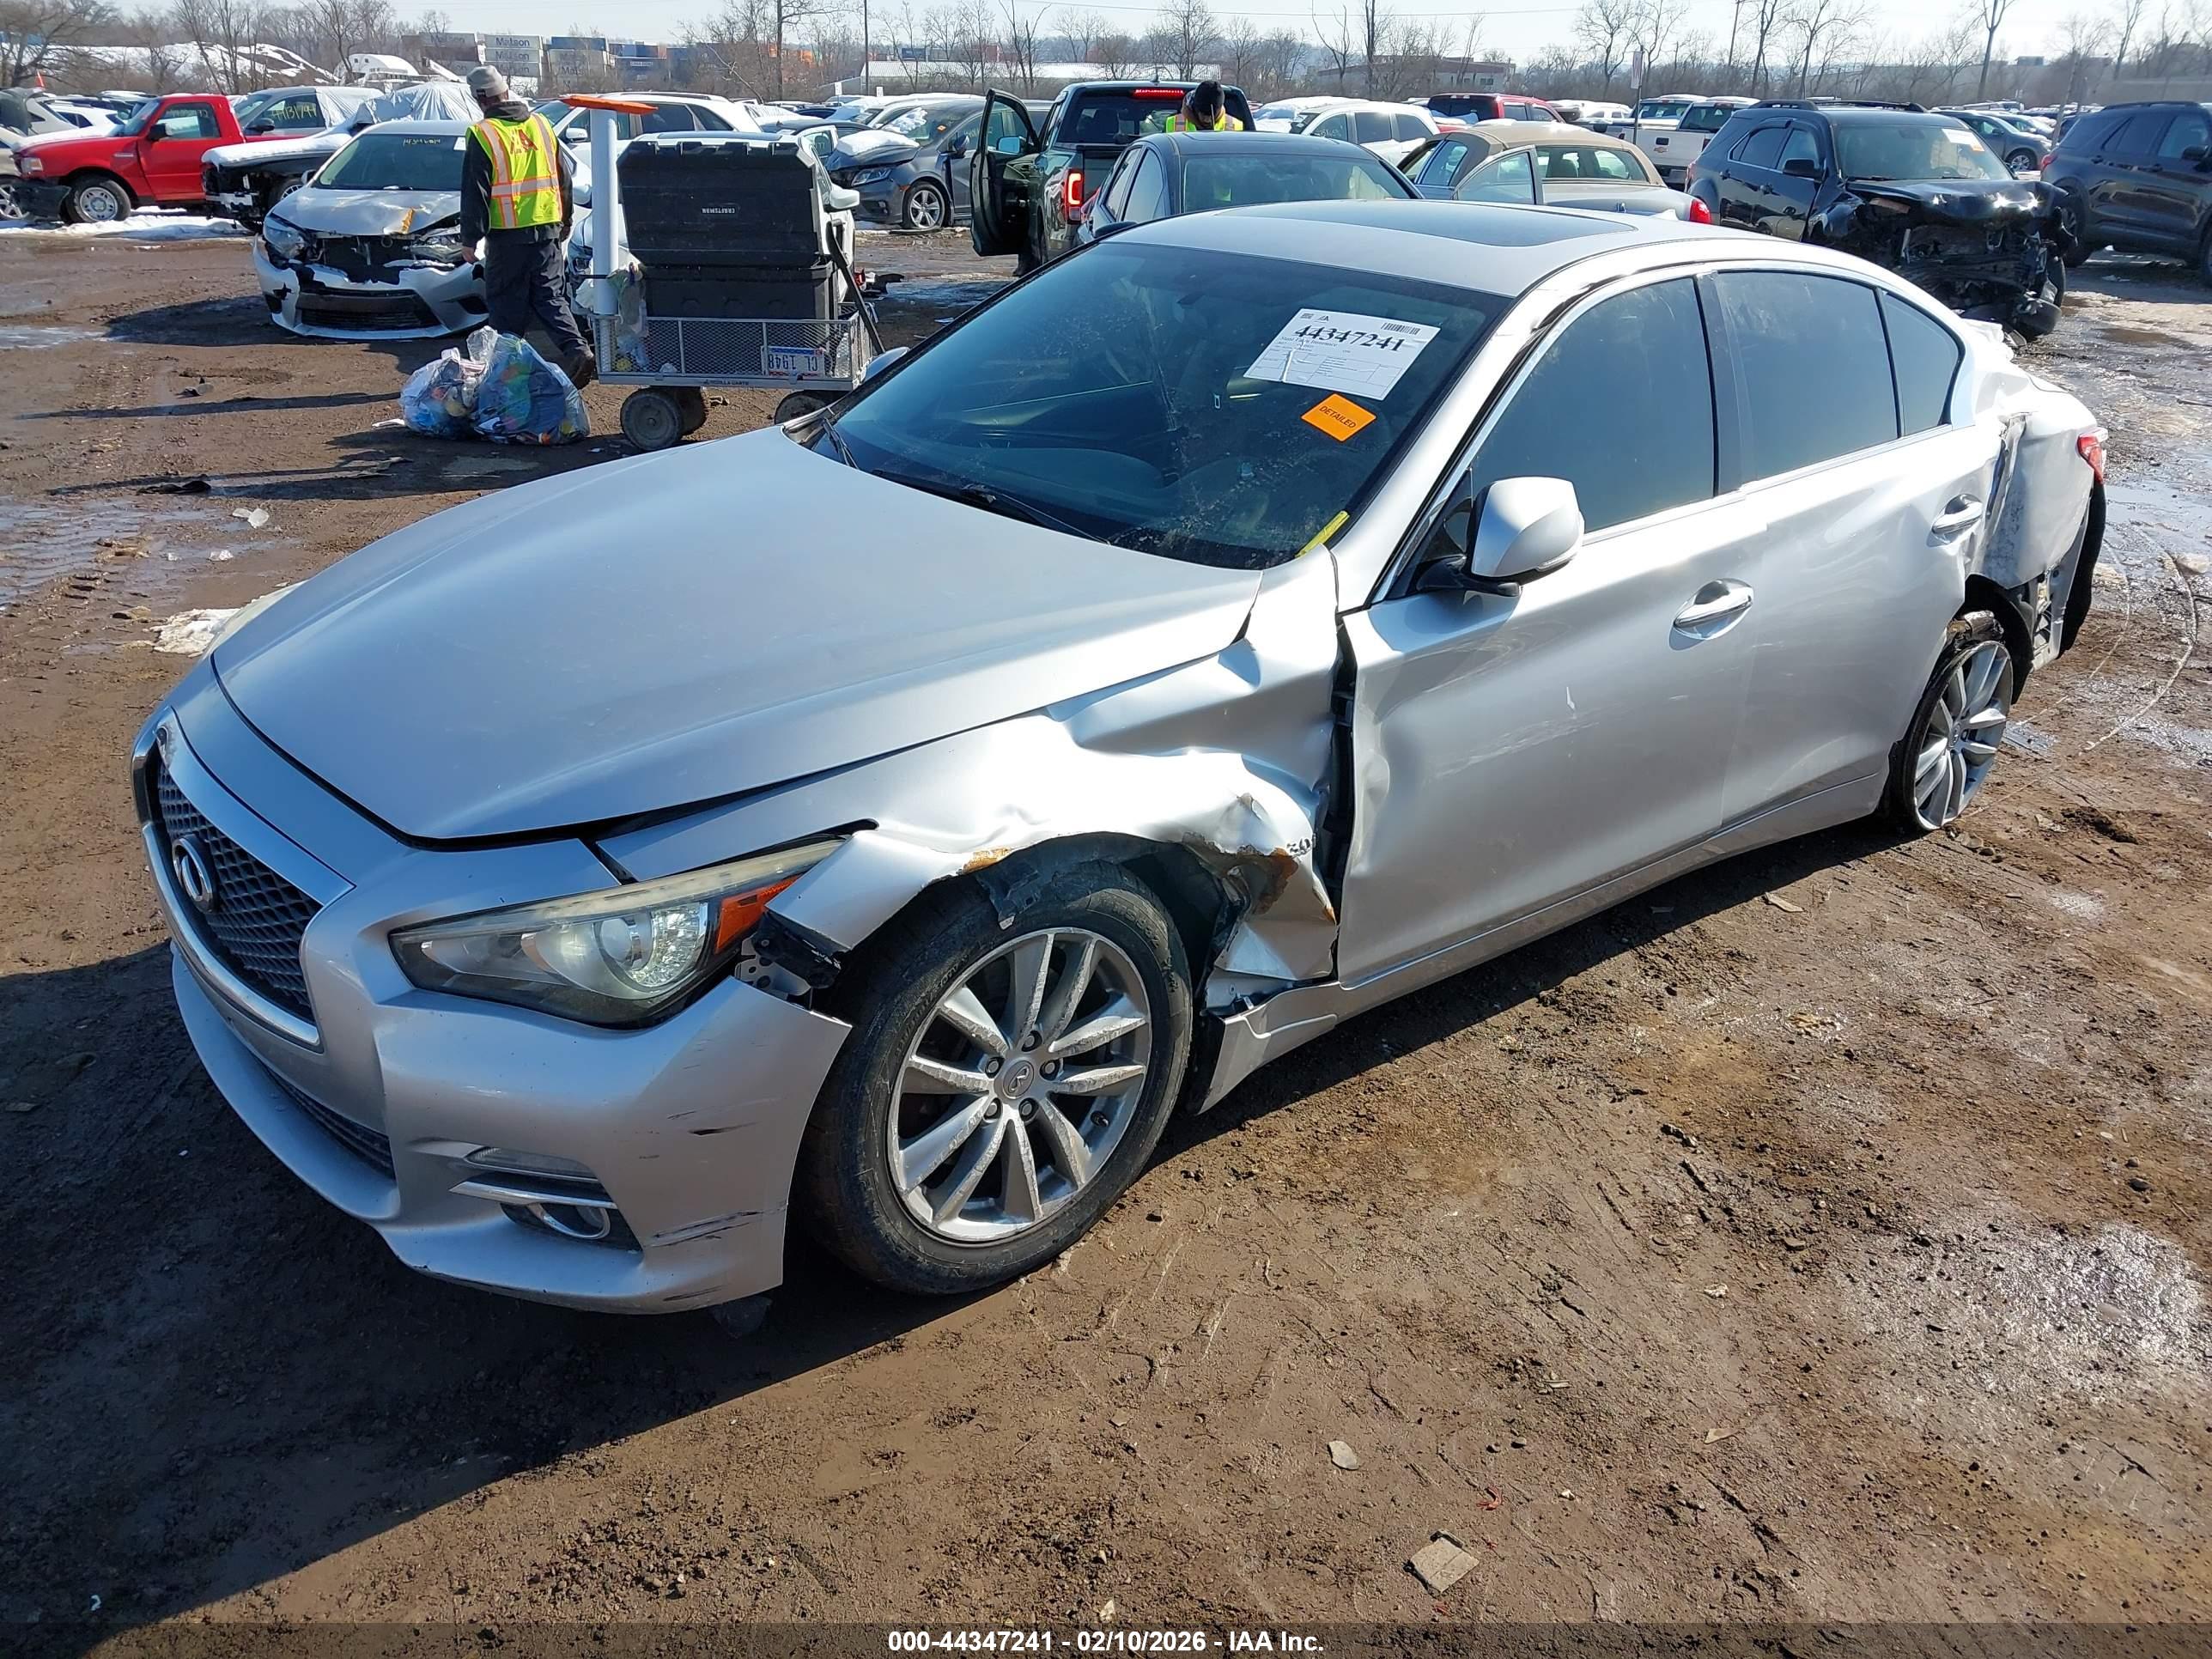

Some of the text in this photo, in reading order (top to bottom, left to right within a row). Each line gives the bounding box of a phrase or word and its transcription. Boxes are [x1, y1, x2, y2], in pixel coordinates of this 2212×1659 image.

[495, 37, 530, 46] Matson
[1295, 325, 1406, 352] 44347241
[769, 353, 818, 371] CL 1948
[1319, 405, 1357, 428] DETAILED
